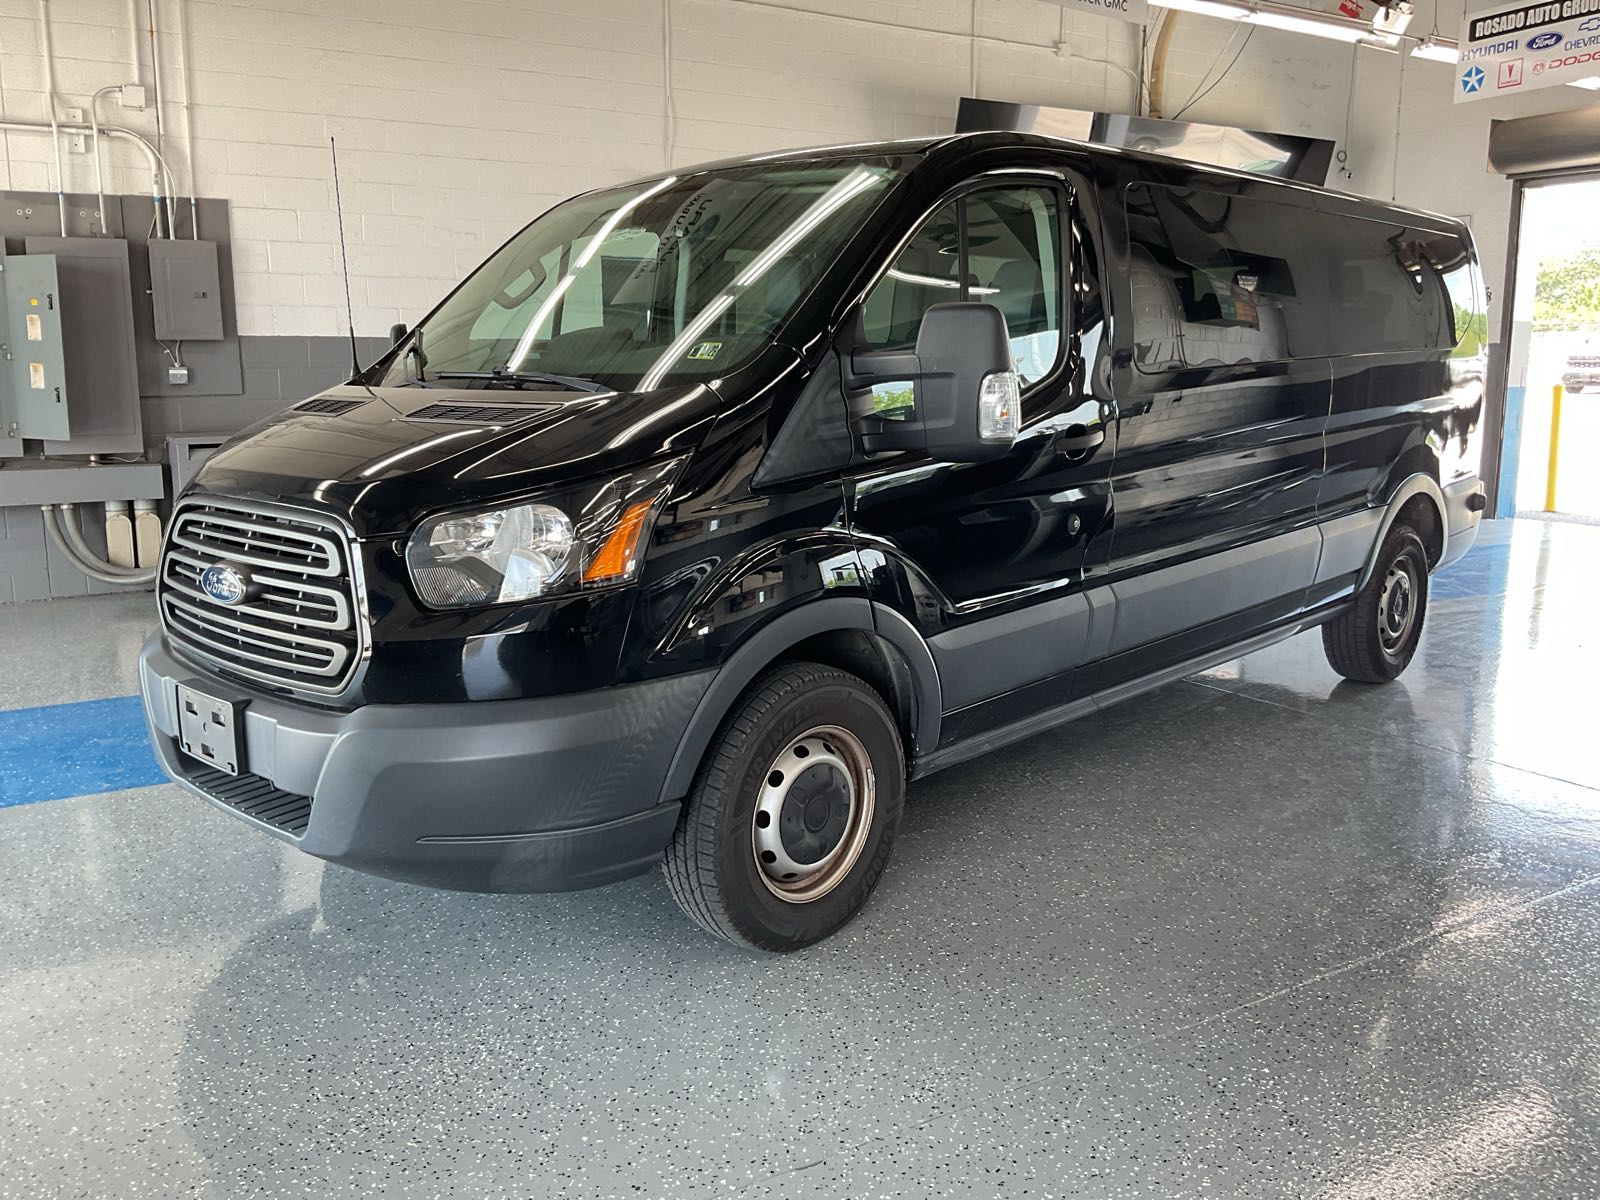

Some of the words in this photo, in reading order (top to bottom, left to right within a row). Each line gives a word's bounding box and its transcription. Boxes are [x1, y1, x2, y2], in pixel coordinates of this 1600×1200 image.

[1104, 0, 1128, 11] GMC
[1475, 12, 1525, 38] ROSADO
[1526, 3, 1560, 26] AUTO
[1561, 0, 1600, 17] GROU
[1461, 39, 1519, 62] HYUNDAI
[206, 571, 234, 597] Ford
